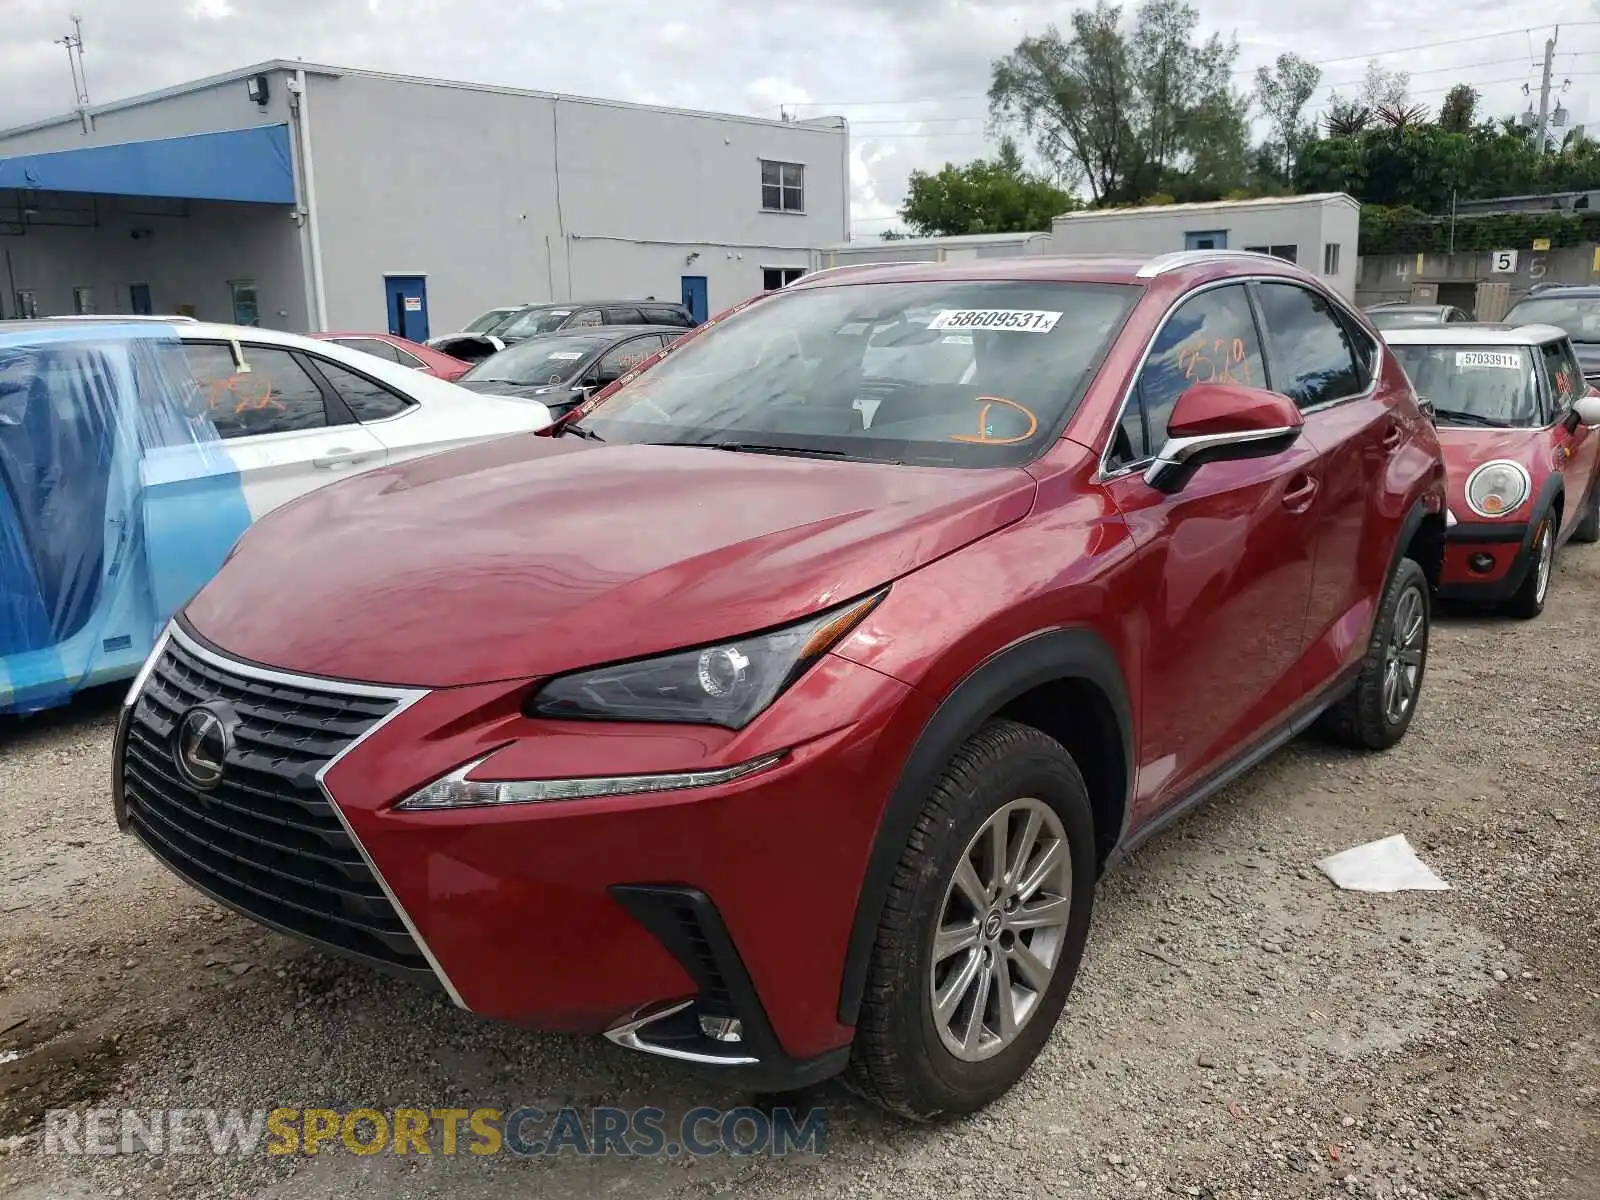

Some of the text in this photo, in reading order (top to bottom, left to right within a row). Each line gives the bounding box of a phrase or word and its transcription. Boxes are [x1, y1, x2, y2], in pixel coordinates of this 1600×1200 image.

[1498, 253, 1511, 271] 5
[1529, 256, 1546, 279] 5
[1396, 263, 1408, 282] 4
